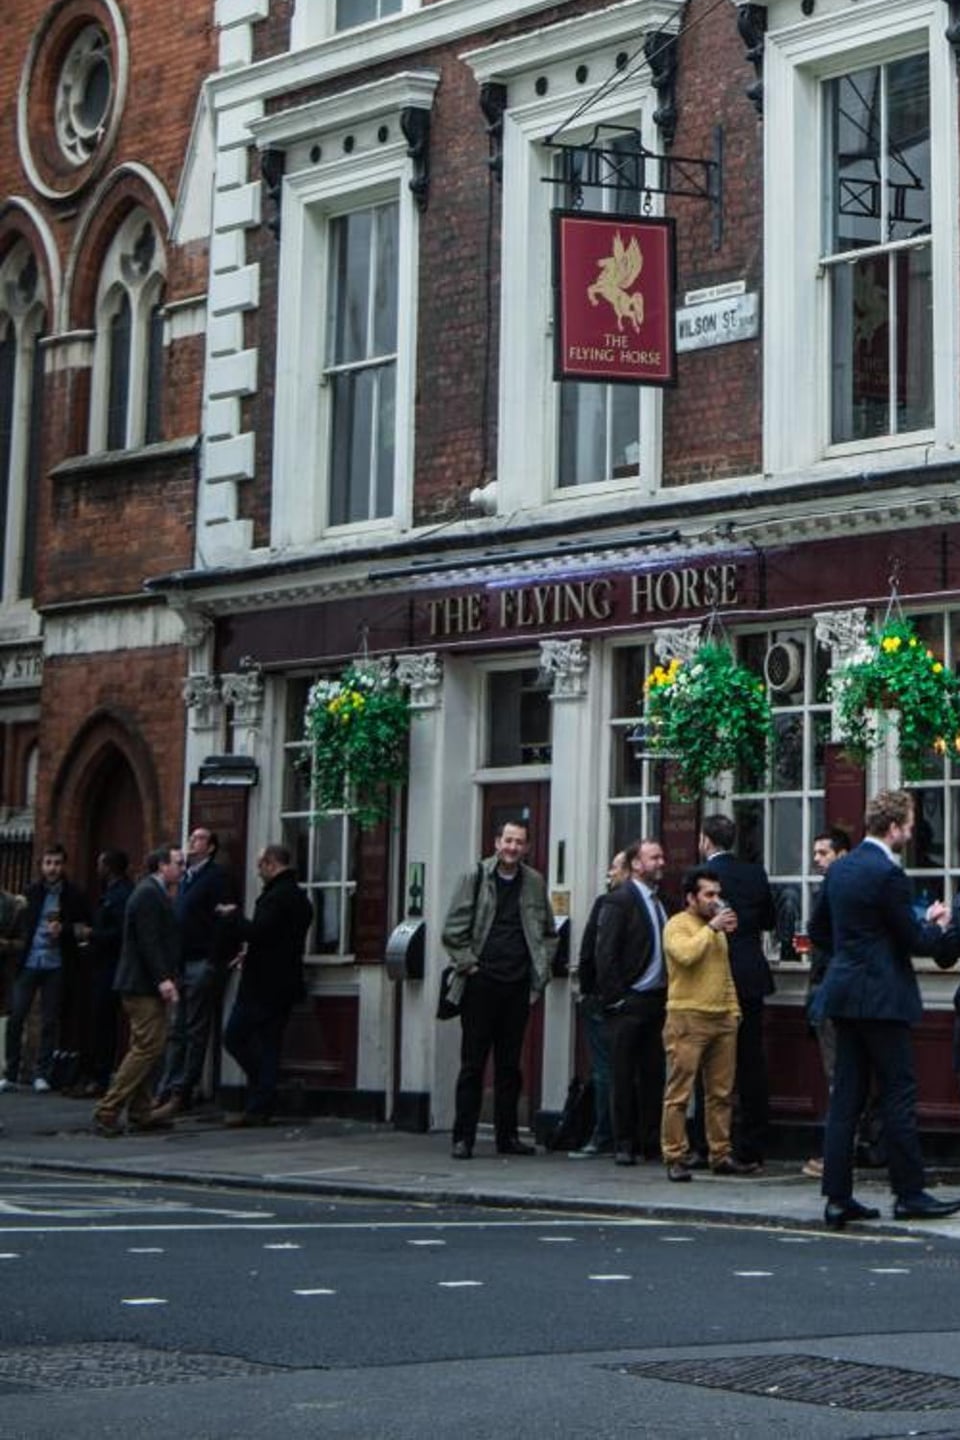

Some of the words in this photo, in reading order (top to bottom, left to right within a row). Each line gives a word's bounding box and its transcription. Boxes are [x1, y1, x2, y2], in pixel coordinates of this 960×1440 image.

[604, 333, 629, 349] THE
[569, 346, 615, 362] FLYING
[620, 349, 661, 366] HORSE
[427, 592, 482, 636] THE
[500, 580, 612, 628] FLYING
[631, 564, 739, 615] HORSE
